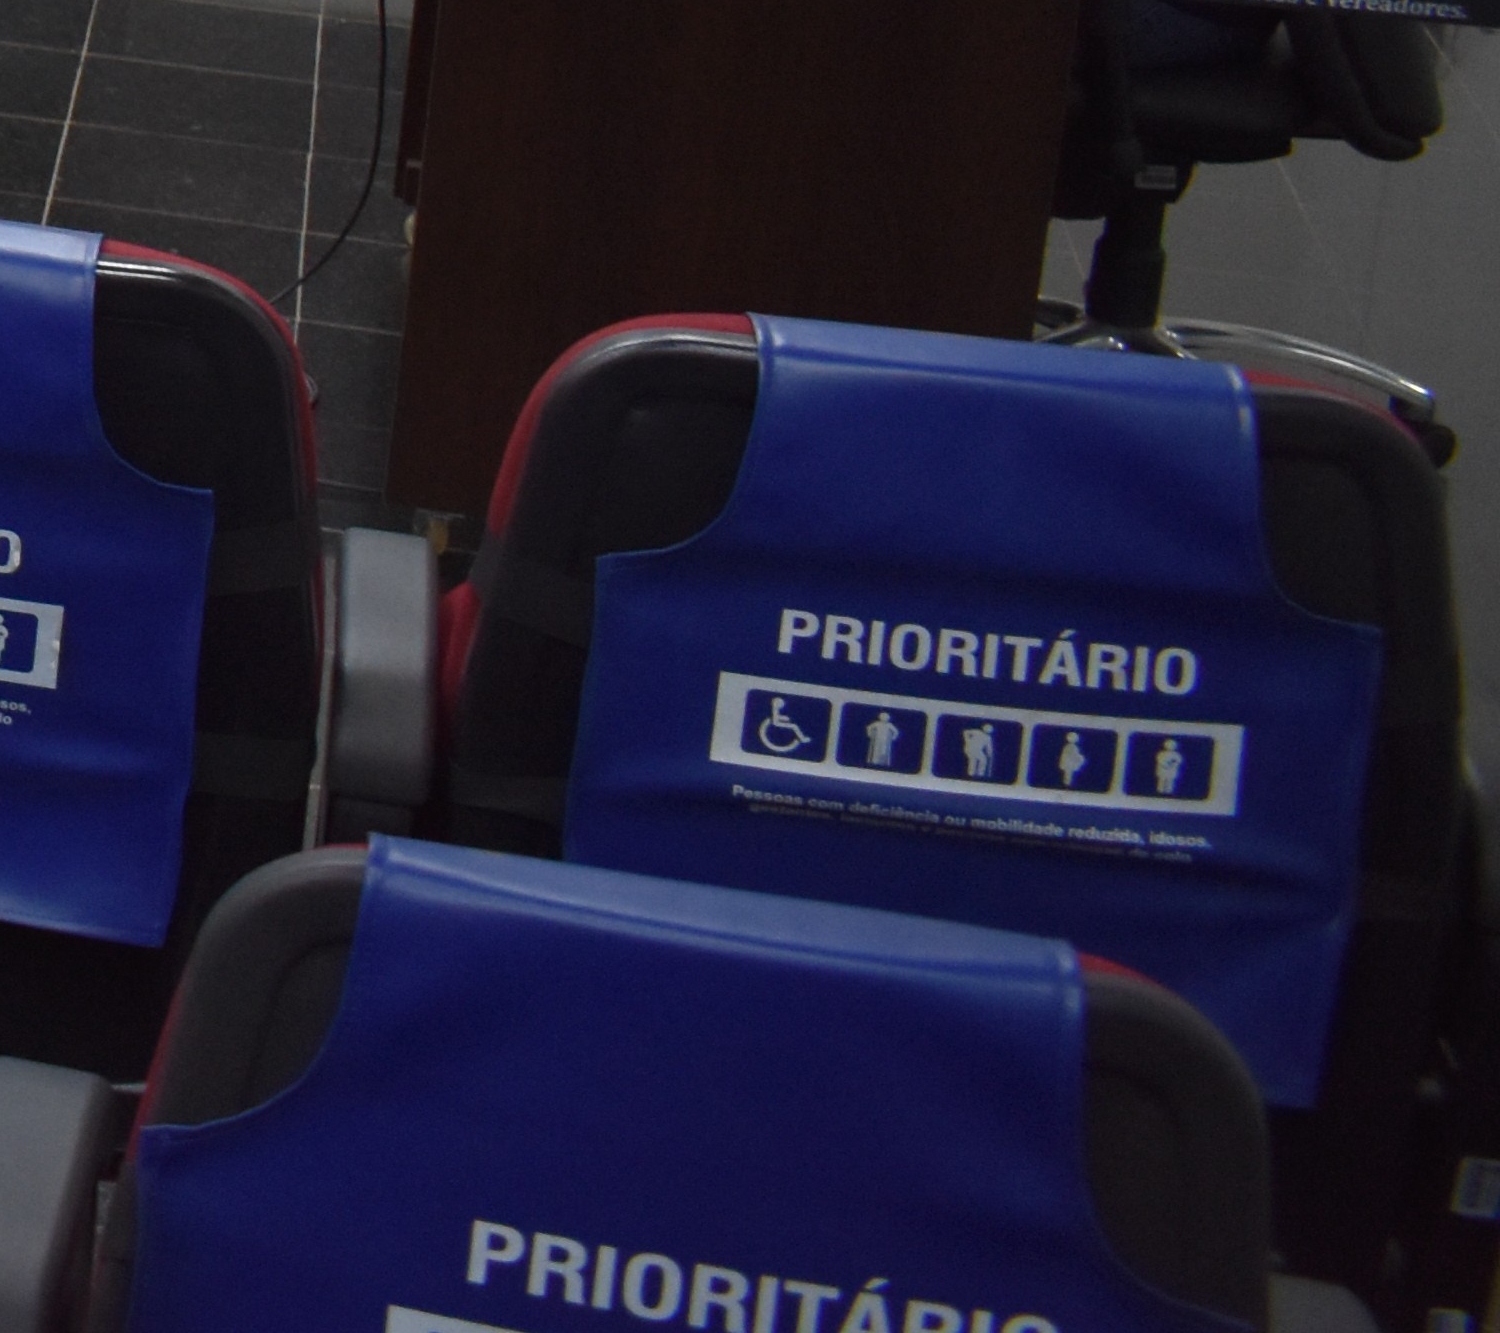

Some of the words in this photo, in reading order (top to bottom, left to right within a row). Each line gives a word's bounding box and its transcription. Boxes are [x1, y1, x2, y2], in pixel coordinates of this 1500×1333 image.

[777, 608, 1197, 696] PRIORITÁRIO
[732, 784, 802, 806] Pessoas
[808, 798, 844, 811] com
[849, 801, 939, 824] deficiência
[944, 814, 966, 826] ou
[971, 817, 1064, 838] mobilidade
[1068, 826, 1145, 845] reduzida,
[1150, 831, 1212, 850] idosos,
[466, 1219, 1059, 1333] PRIORITÁR
